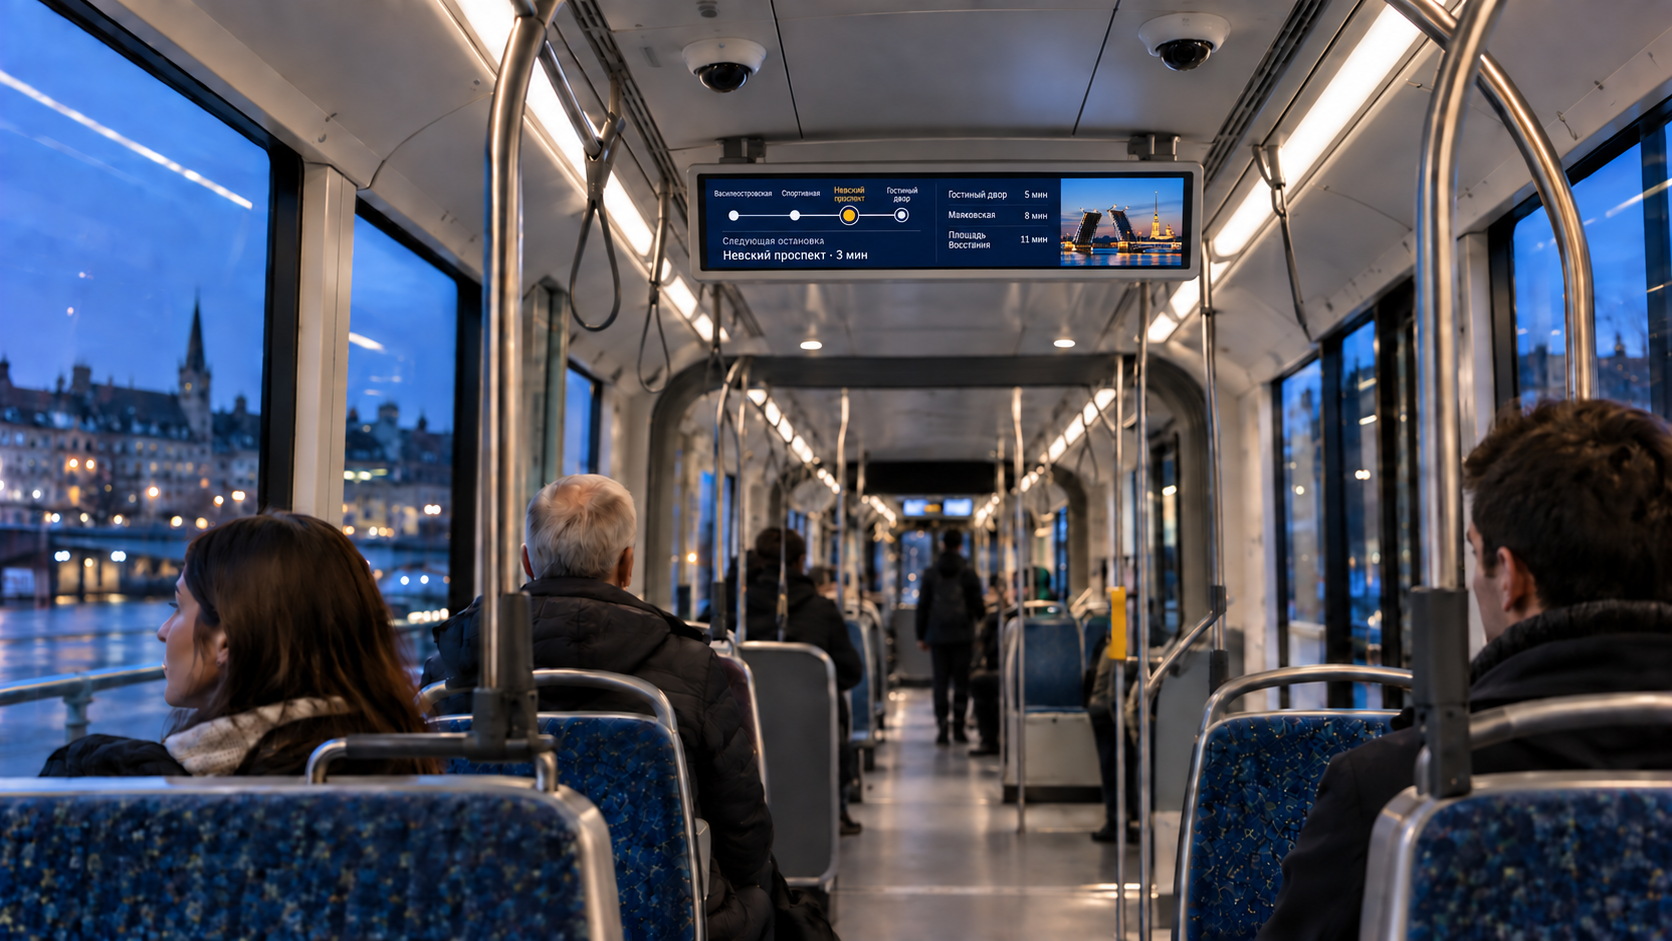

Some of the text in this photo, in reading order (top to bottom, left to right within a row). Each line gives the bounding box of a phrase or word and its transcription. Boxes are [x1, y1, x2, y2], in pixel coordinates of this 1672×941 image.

[781, 188, 821, 199] Спортивная
[948, 189, 1008, 201] Гостиный двор
[1024, 190, 1048, 199] 5 мин
[948, 210, 996, 219] Маяковская
[1024, 211, 1030, 220] 8
[948, 230, 986, 241] Площадь
[1020, 235, 1030, 244] 11
[722, 236, 825, 247] Следующая остановка
[948, 240, 991, 250] Восстания
[723, 249, 771, 261] Невский
[774, 251, 827, 263] проспект
[836, 249, 844, 261] 3
[845, 251, 868, 261] мин
